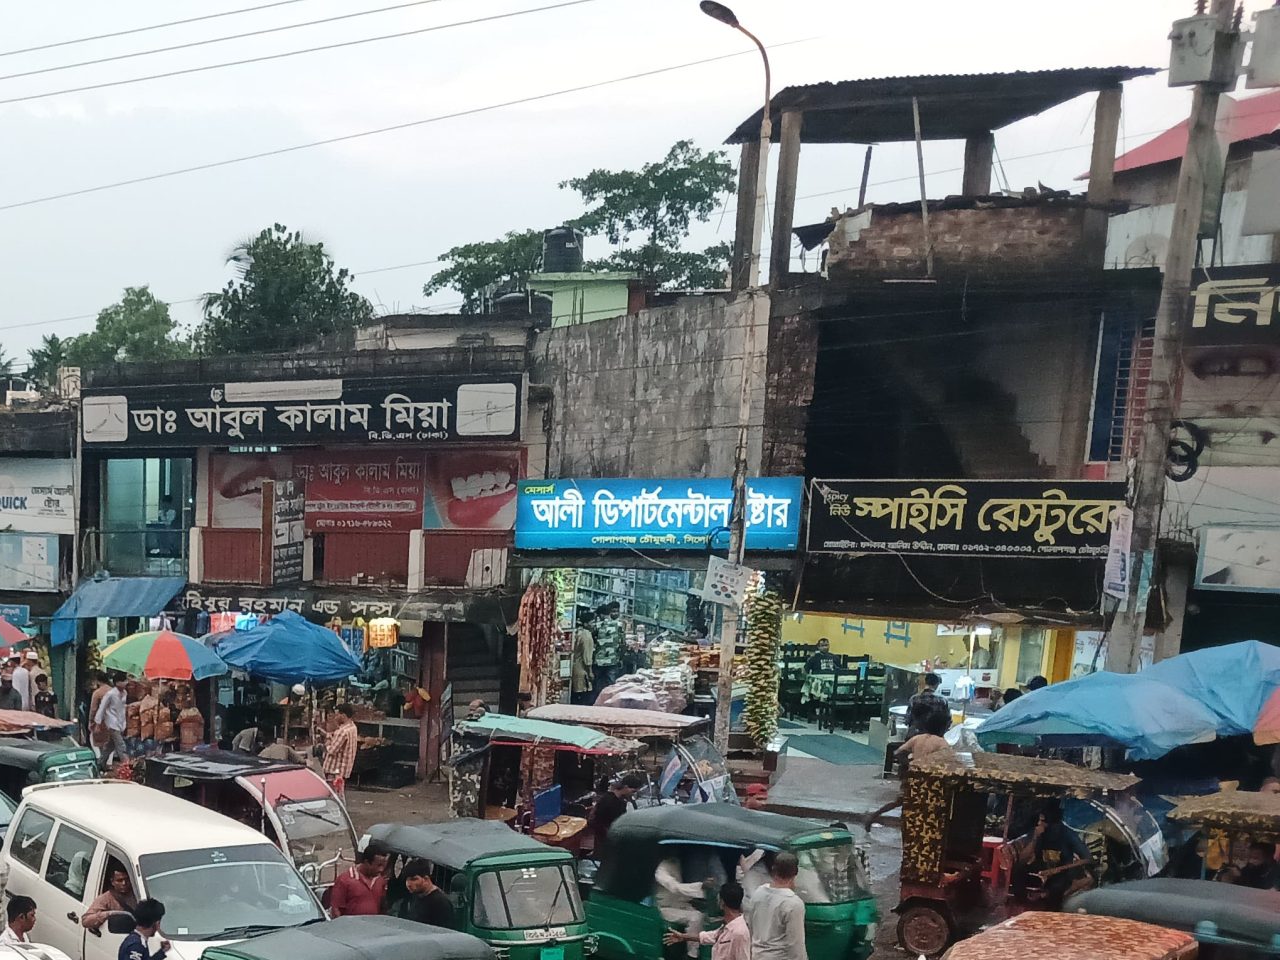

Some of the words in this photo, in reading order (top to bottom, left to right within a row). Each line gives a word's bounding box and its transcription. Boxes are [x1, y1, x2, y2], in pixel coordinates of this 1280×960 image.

[131, 406, 177, 435] ডাঃ
[185, 404, 267, 440] আবুল
[274, 401, 372, 433] কালাম
[380, 393, 453, 431] মিয়া
[531, 489, 585, 528] আলী
[593, 487, 732, 528] ডিপার্টমেন্টাল
[853, 484, 968, 533] স্পাইসি
[977, 488, 1125, 545] রেস্টুরে
[239, 597, 305, 614] রহমান
[351, 600, 396, 615] সন্স
